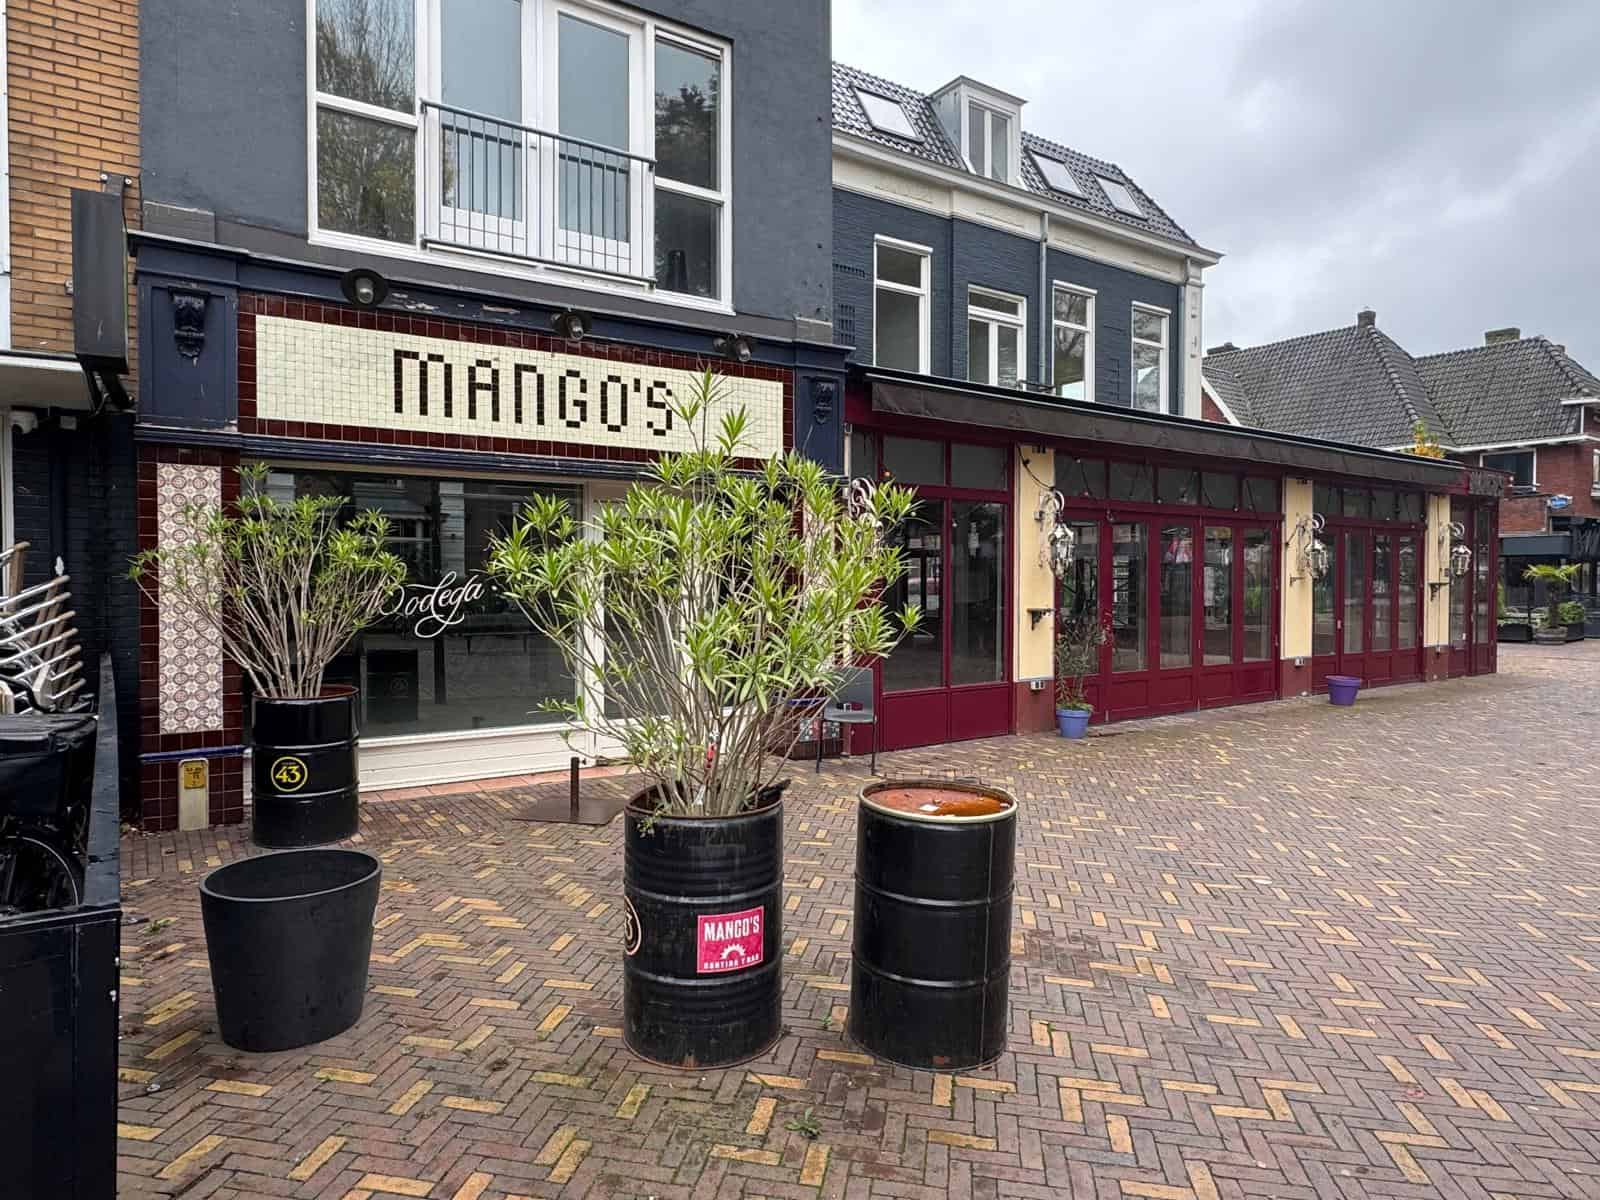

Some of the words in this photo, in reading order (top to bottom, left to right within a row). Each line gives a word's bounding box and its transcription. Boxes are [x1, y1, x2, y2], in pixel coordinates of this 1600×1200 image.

[393, 348, 673, 437] MANGO'S
[275, 765, 302, 784] 43
[703, 914, 760, 942] MANGO'S
